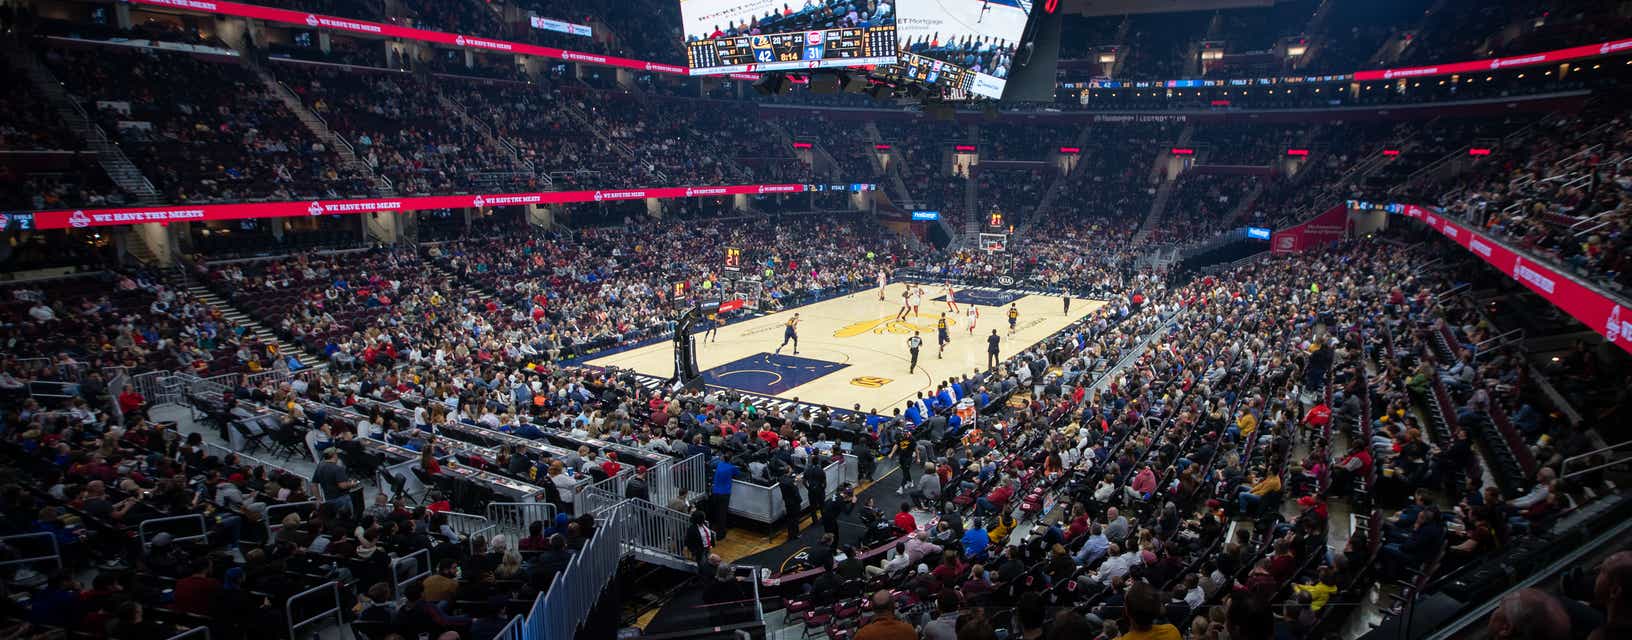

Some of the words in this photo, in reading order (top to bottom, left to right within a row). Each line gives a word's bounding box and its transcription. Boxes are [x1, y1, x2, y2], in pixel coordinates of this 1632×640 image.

[759, 51, 771, 62] 42
[808, 47, 819, 59] 31
[92, 214, 113, 222] WE
[113, 213, 145, 221] HAVE
[144, 211, 168, 219] THE
[168, 210, 204, 219] MEATS
[20, 219, 31, 230] 2
[726, 254, 738, 266] 21
